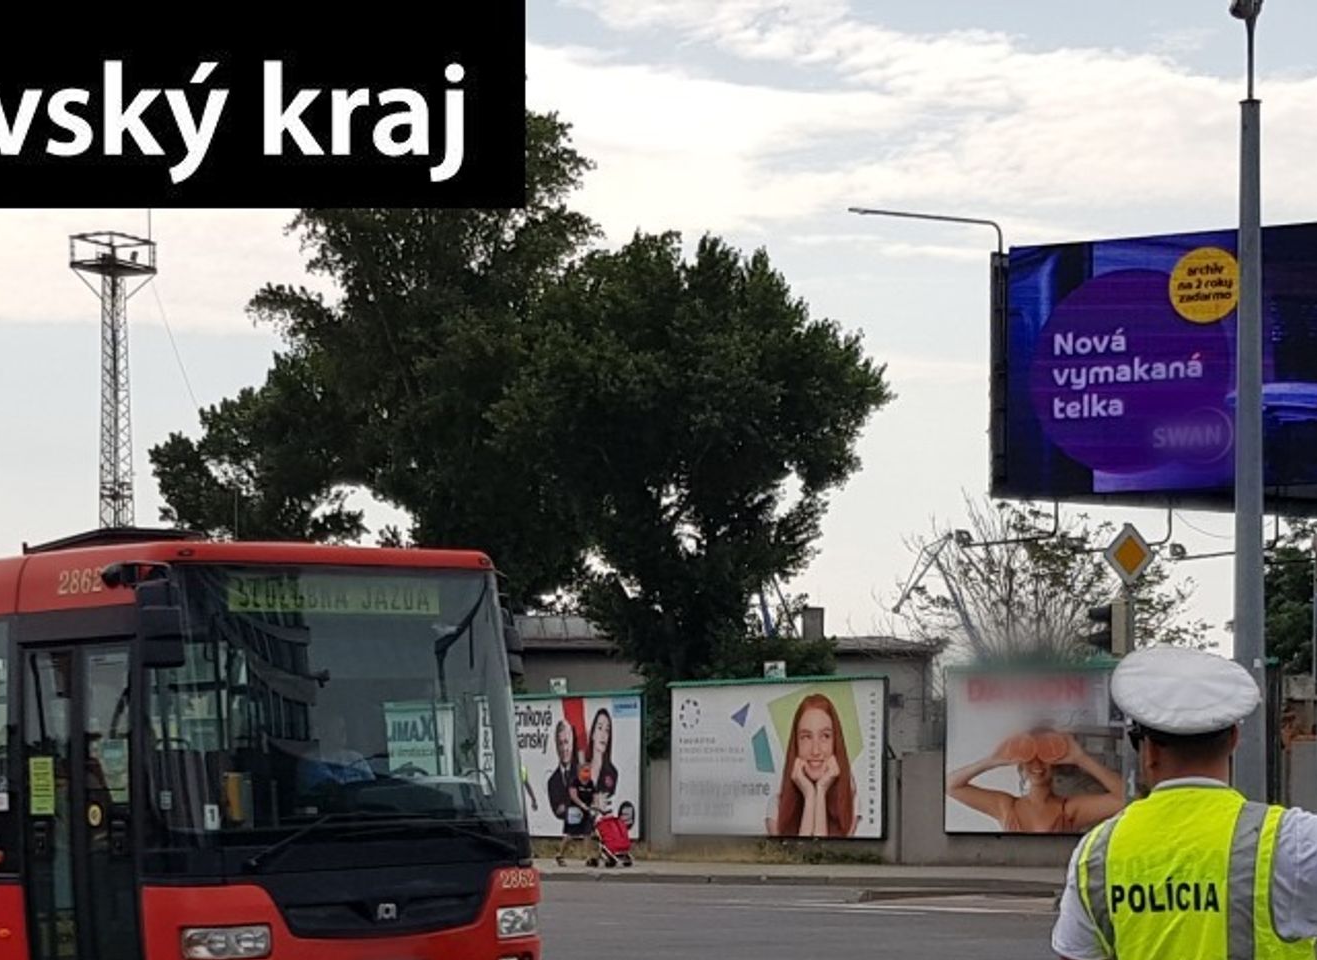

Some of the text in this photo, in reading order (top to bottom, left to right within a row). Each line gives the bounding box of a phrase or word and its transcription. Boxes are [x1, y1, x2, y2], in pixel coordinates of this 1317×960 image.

[1177, 278, 1233, 291] na 2 roky
[1179, 291, 1232, 303] zadarmo
[1053, 327, 1127, 356] Nová
[1052, 352, 1203, 390] vymakaná
[1053, 393, 1124, 419] telka
[1152, 424, 1222, 449] SWAN
[57, 567, 103, 595] 2862
[499, 869, 535, 888] 2862
[1110, 876, 1220, 913] POLÍCIA
